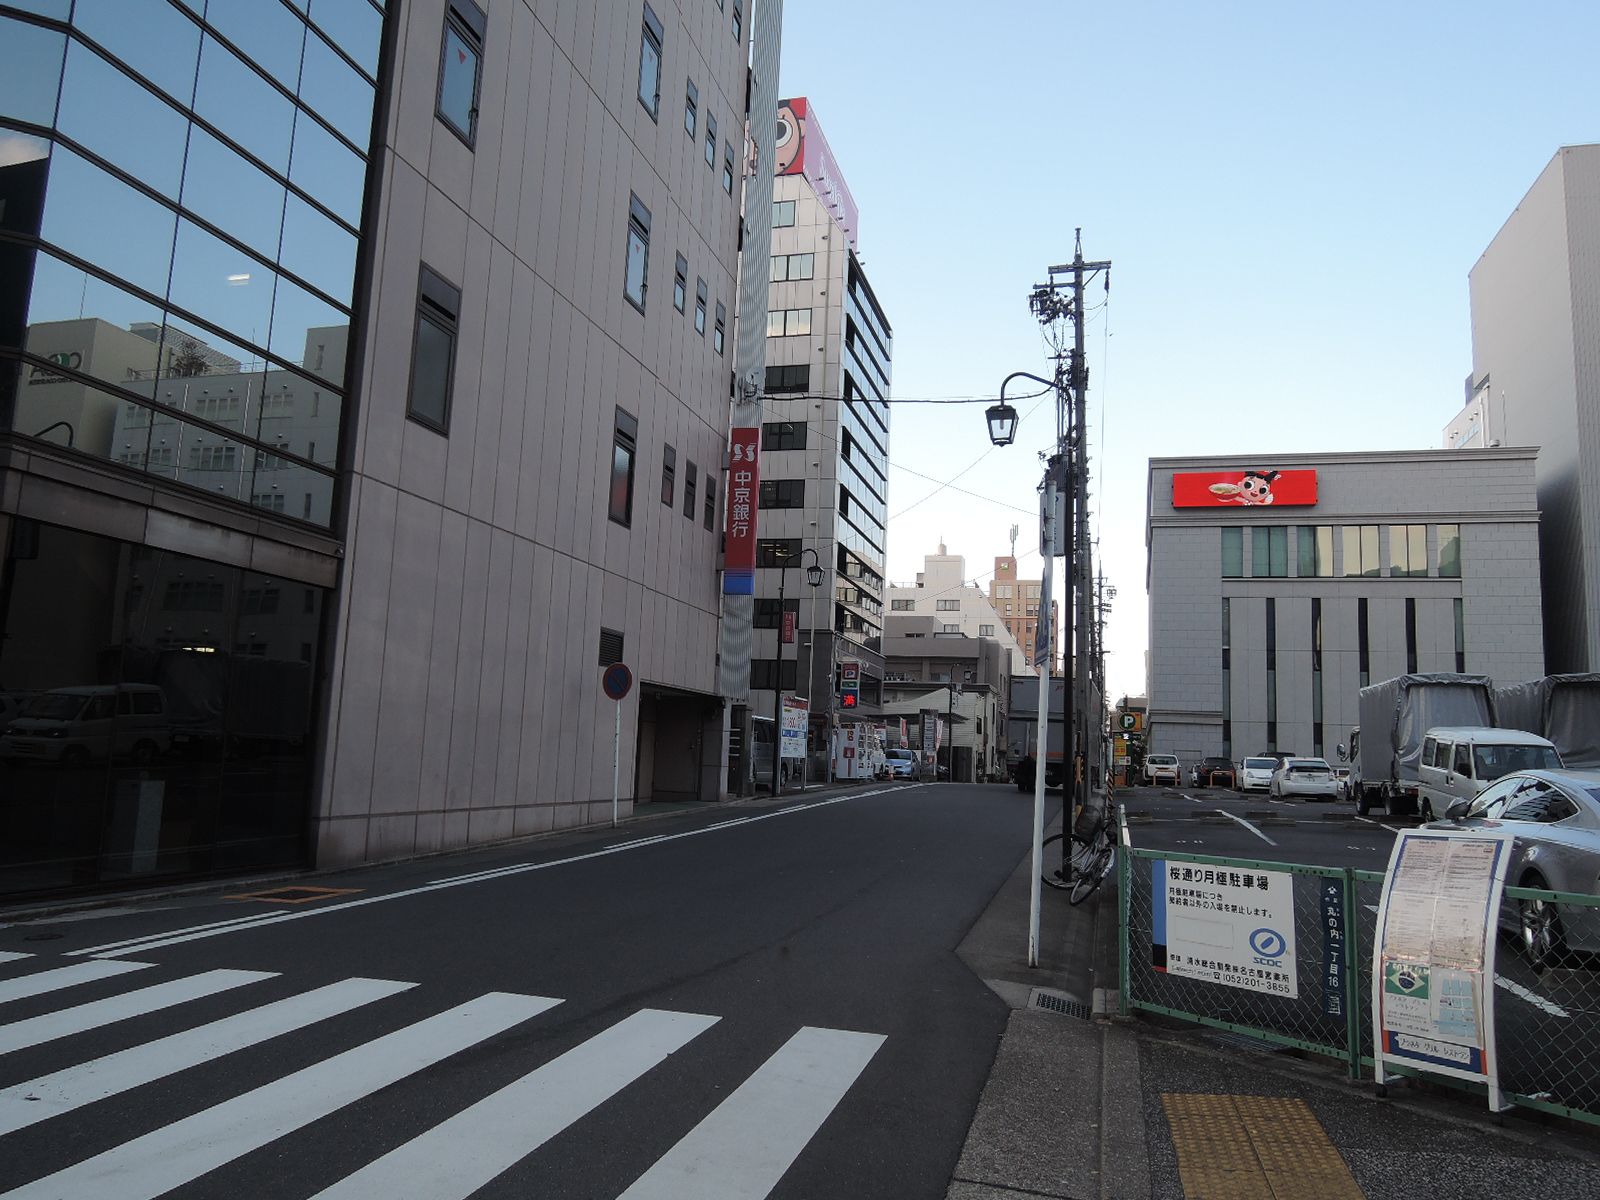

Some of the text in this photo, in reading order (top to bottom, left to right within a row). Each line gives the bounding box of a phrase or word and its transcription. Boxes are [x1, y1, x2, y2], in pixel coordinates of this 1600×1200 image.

[732, 470, 752, 538] 中京銀行
[1124, 715, 1134, 728] P
[1169, 866, 1269, 891] 桜通り月極駐車場
[1168, 887, 1223, 901] 月極駐車場につき
[1168, 896, 1273, 919] 契約者以外の入場を禁止します。
[1223, 973, 1291, 994] (052)201-3855
